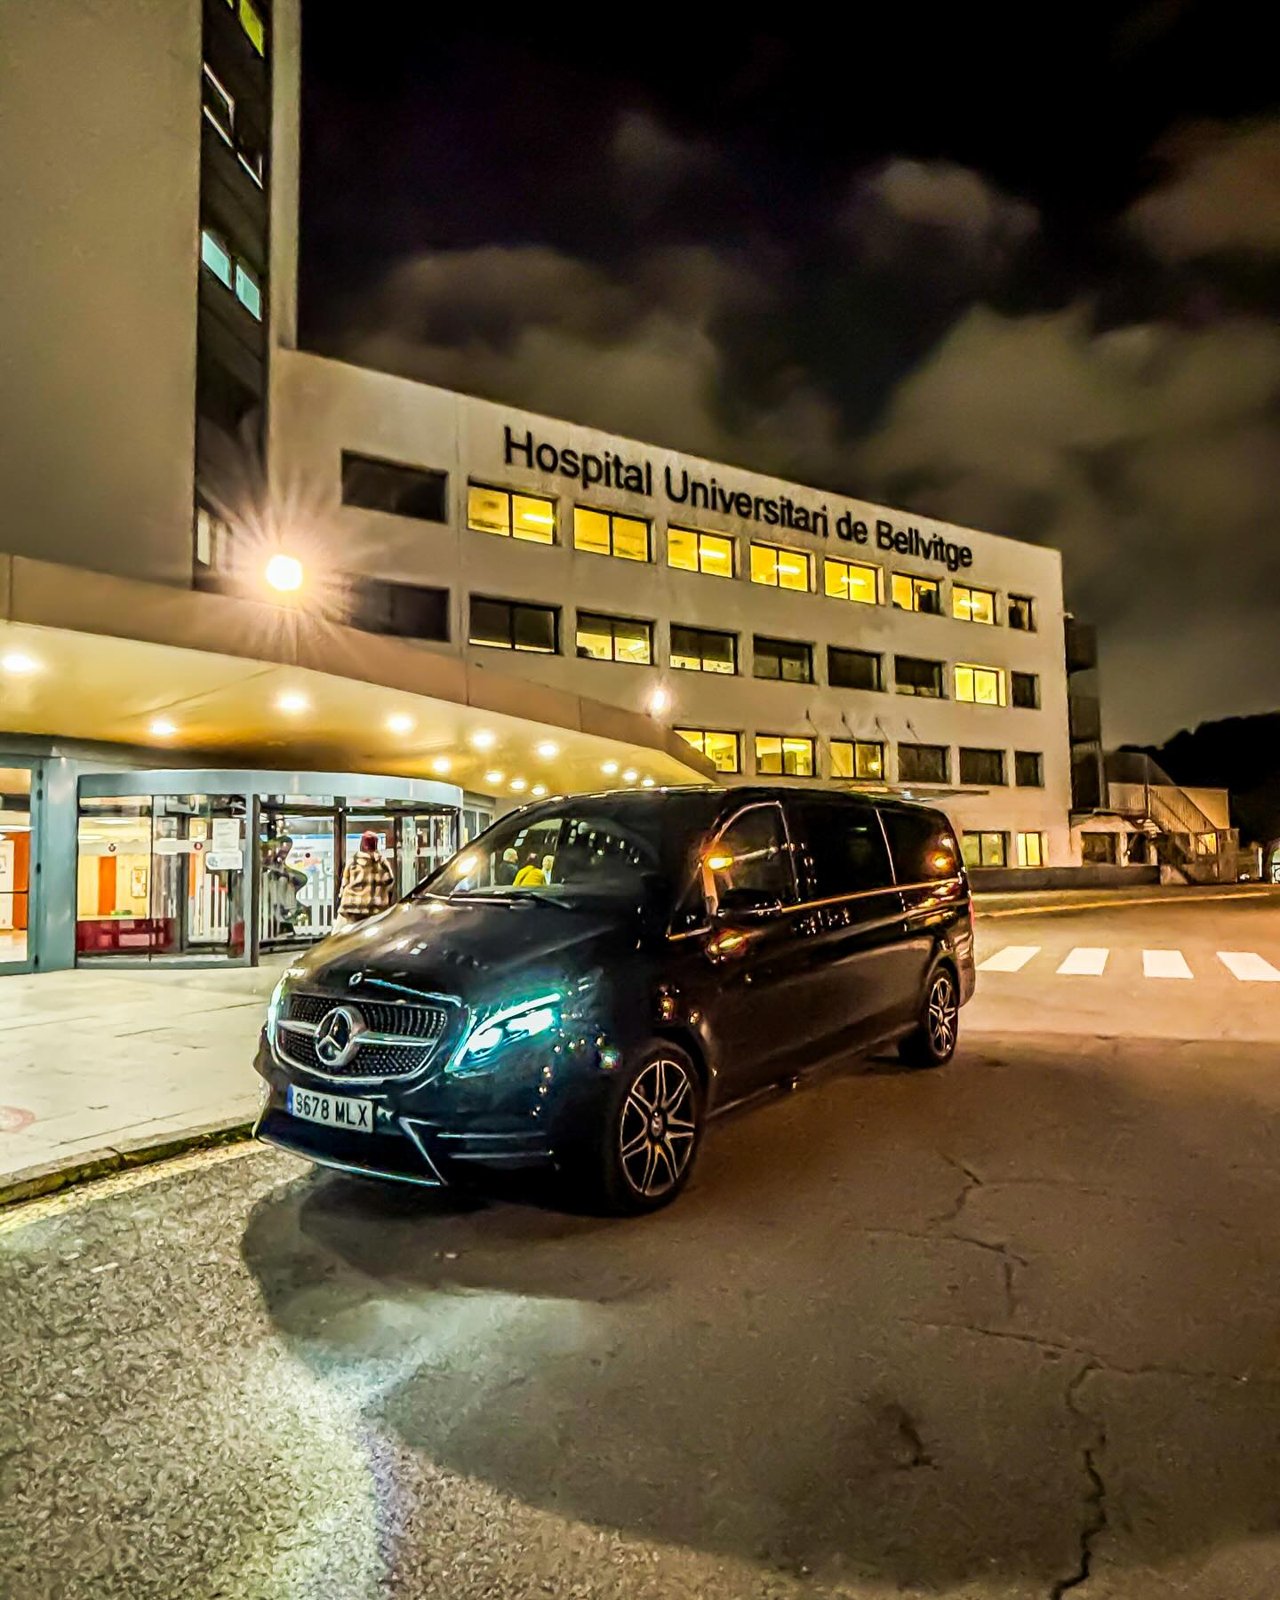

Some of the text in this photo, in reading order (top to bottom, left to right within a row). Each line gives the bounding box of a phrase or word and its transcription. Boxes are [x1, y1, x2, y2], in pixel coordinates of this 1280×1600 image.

[503, 425, 973, 571] Hospital Universitari de Bellvitge
[335, 1101, 368, 1127] MLX
